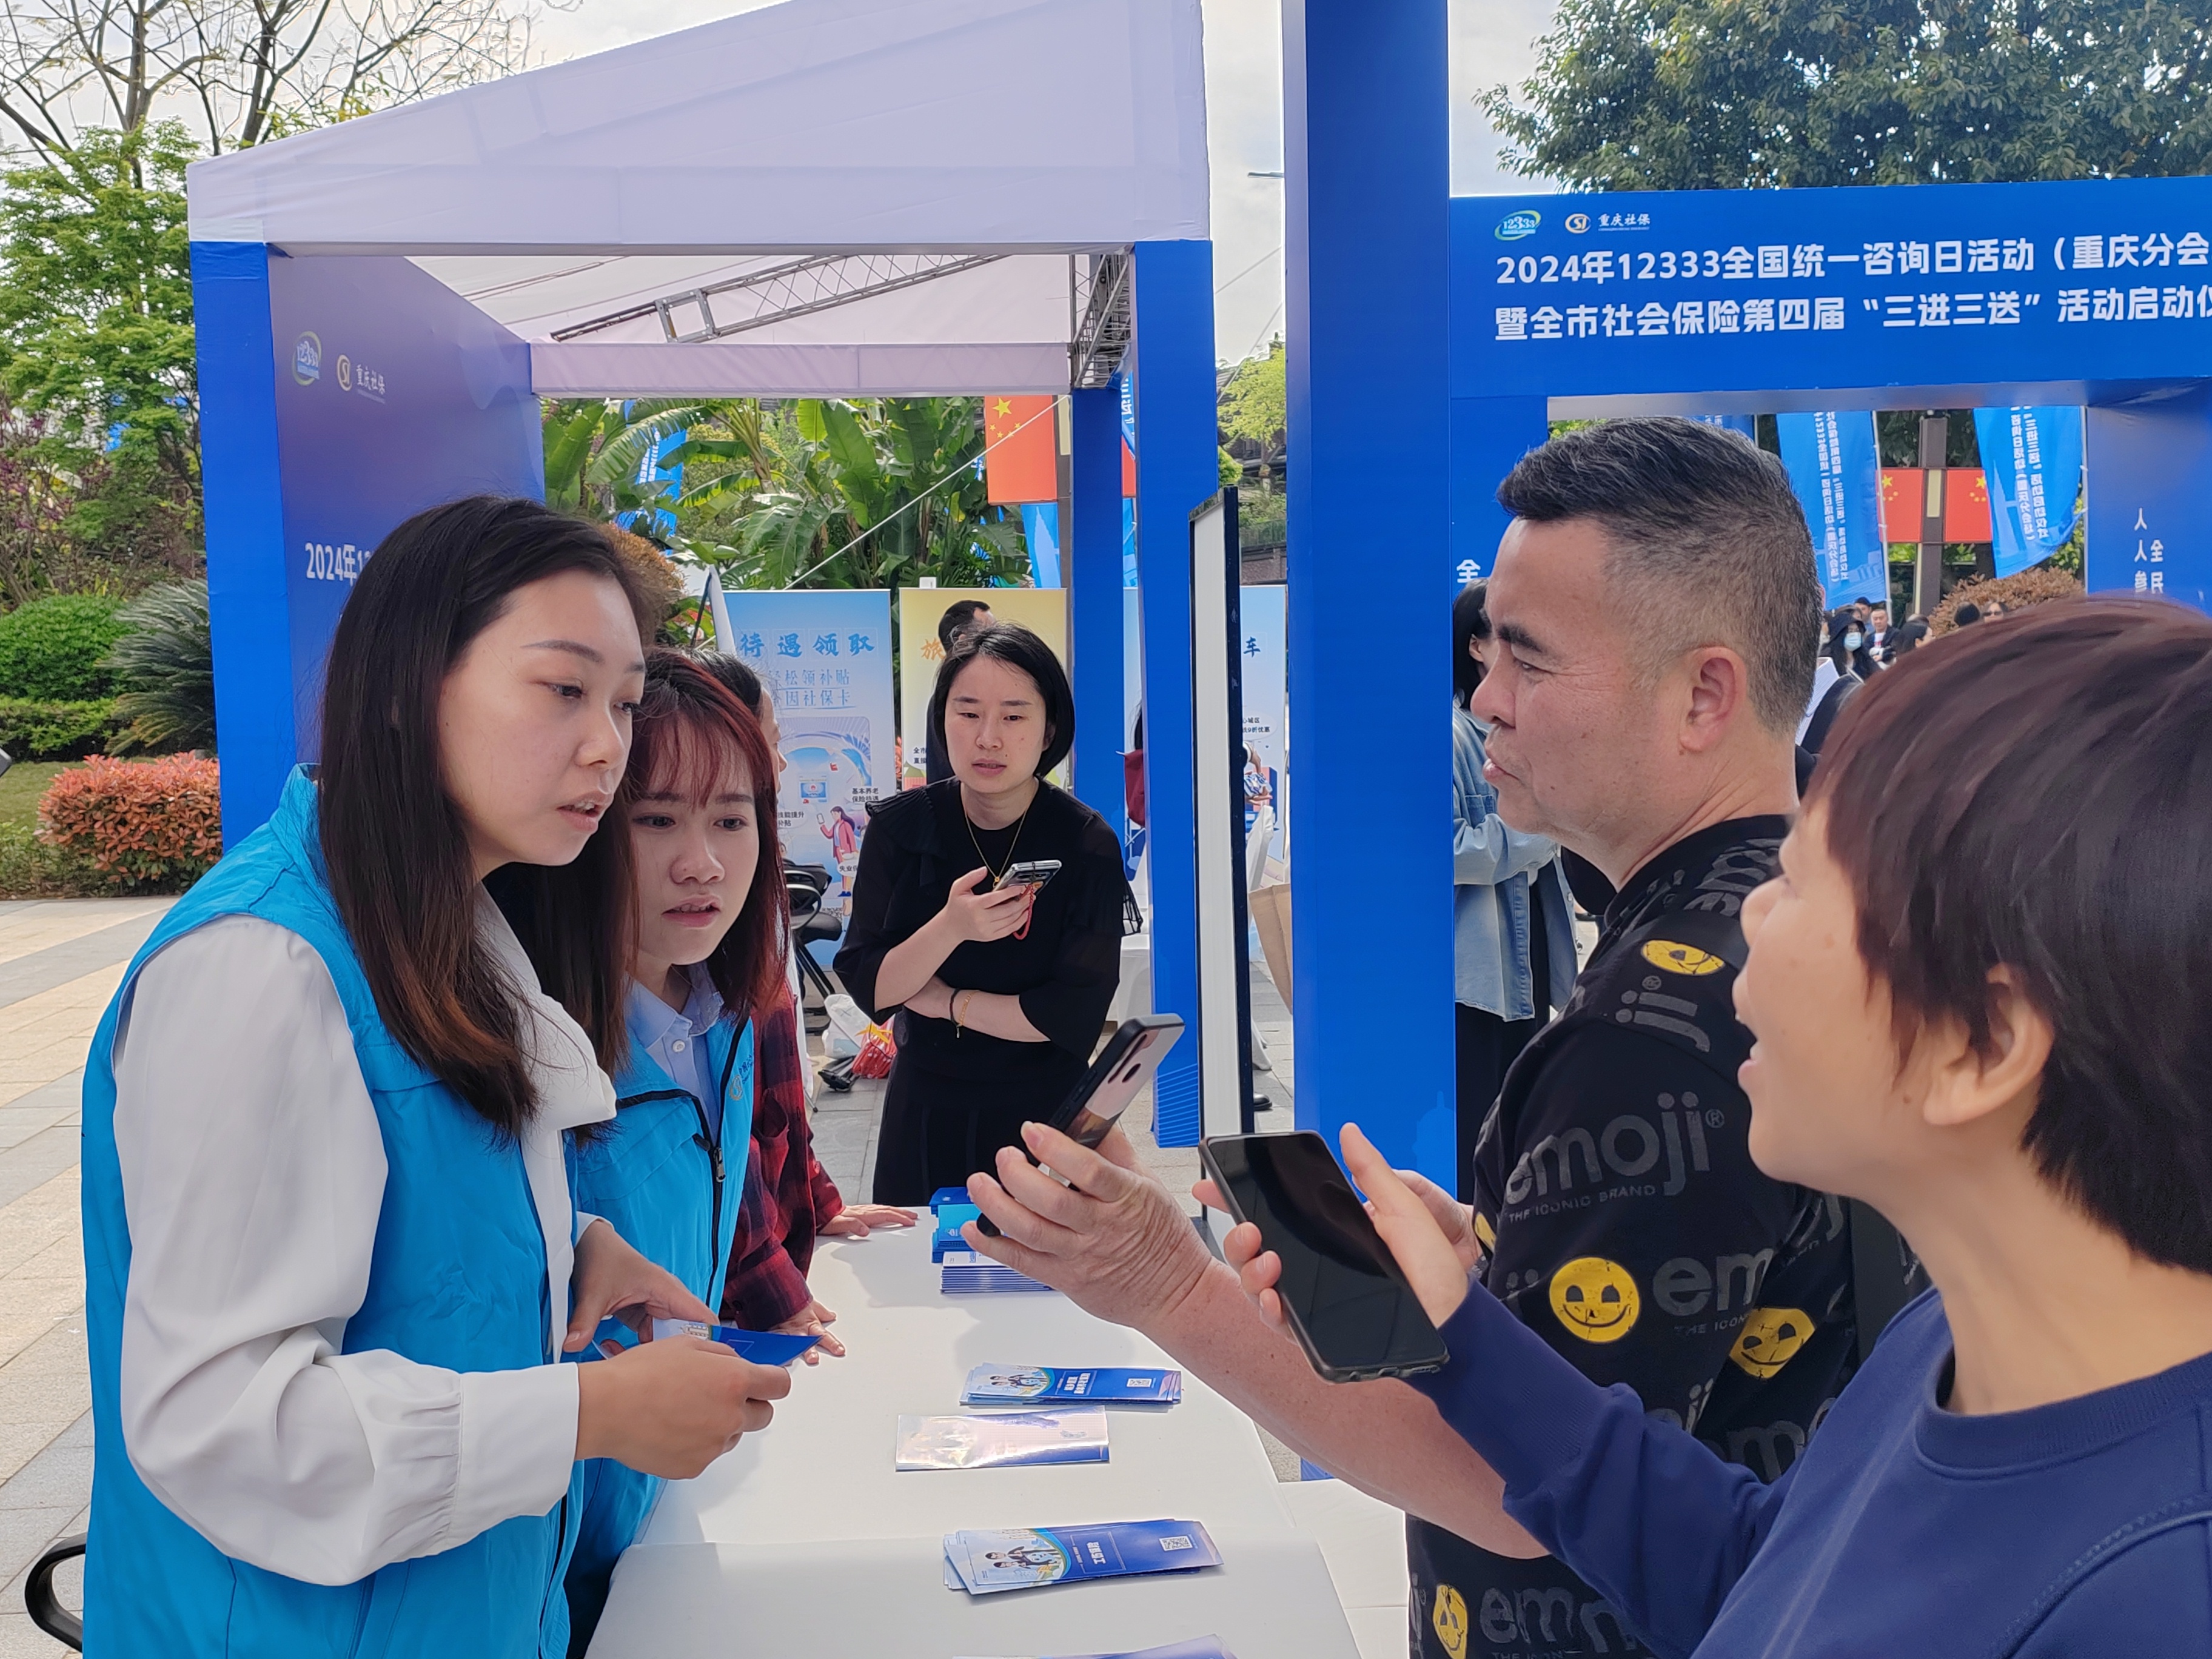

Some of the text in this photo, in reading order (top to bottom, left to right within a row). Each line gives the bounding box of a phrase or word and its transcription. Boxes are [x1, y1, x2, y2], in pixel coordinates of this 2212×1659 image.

[1503, 216, 1535, 230] 12333
[1598, 213, 1651, 227] 重庆社保
[2150, 539, 2163, 594] 全民
[740, 632, 875, 657] 待遇领取
[920, 637, 947, 660] 旅
[1243, 636, 1261, 658] 车
[771, 689, 850, 706] 因社保卡
[1599, 1184, 1656, 1204] BRAND
